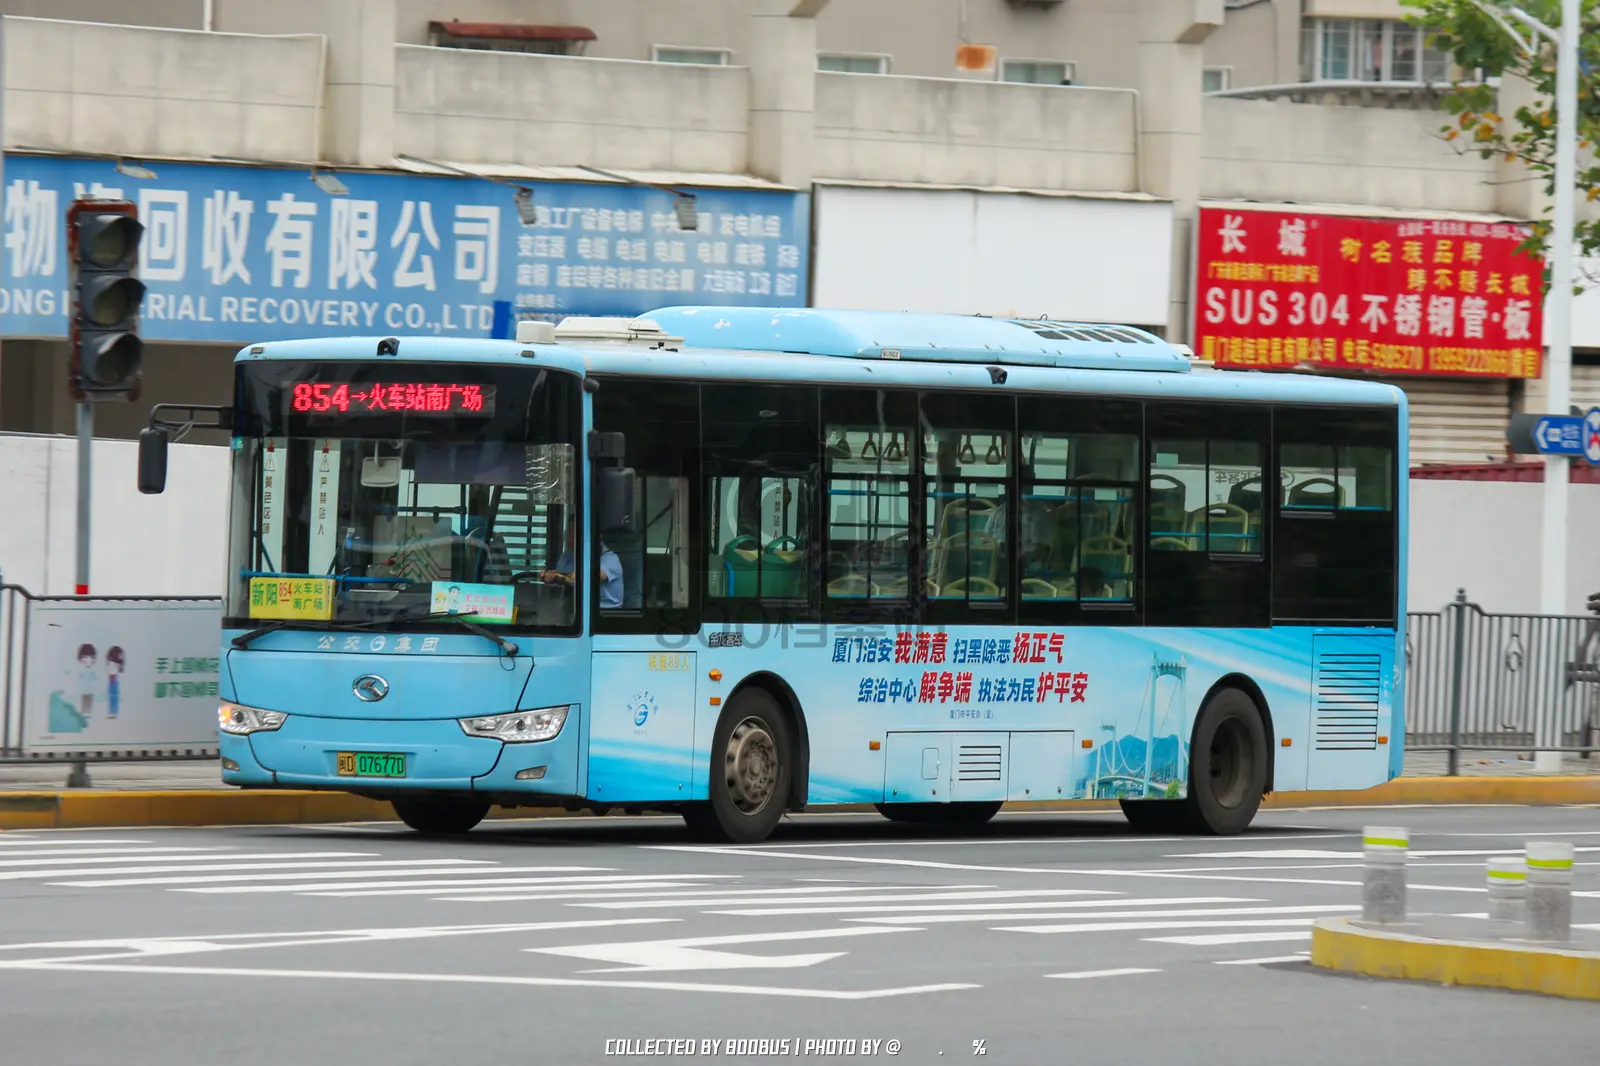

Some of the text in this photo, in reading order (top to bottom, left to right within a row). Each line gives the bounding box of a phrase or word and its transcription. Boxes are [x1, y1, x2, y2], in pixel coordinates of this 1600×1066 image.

[5, 179, 501, 294] 物回收有限公司
[1218, 214, 1308, 257] 长城
[221, 297, 379, 329] RECOVERY
[384, 302, 494, 335] CO.,LTD
[1205, 286, 1279, 326] SUS
[1287, 291, 1350, 327] 304
[293, 383, 483, 412] 854 火车站南广场
[831, 632, 1065, 665] 厦门治安我满意 扫黑除恶扬正气
[857, 671, 1089, 704] 综治中心解争端 执法为民护平安
